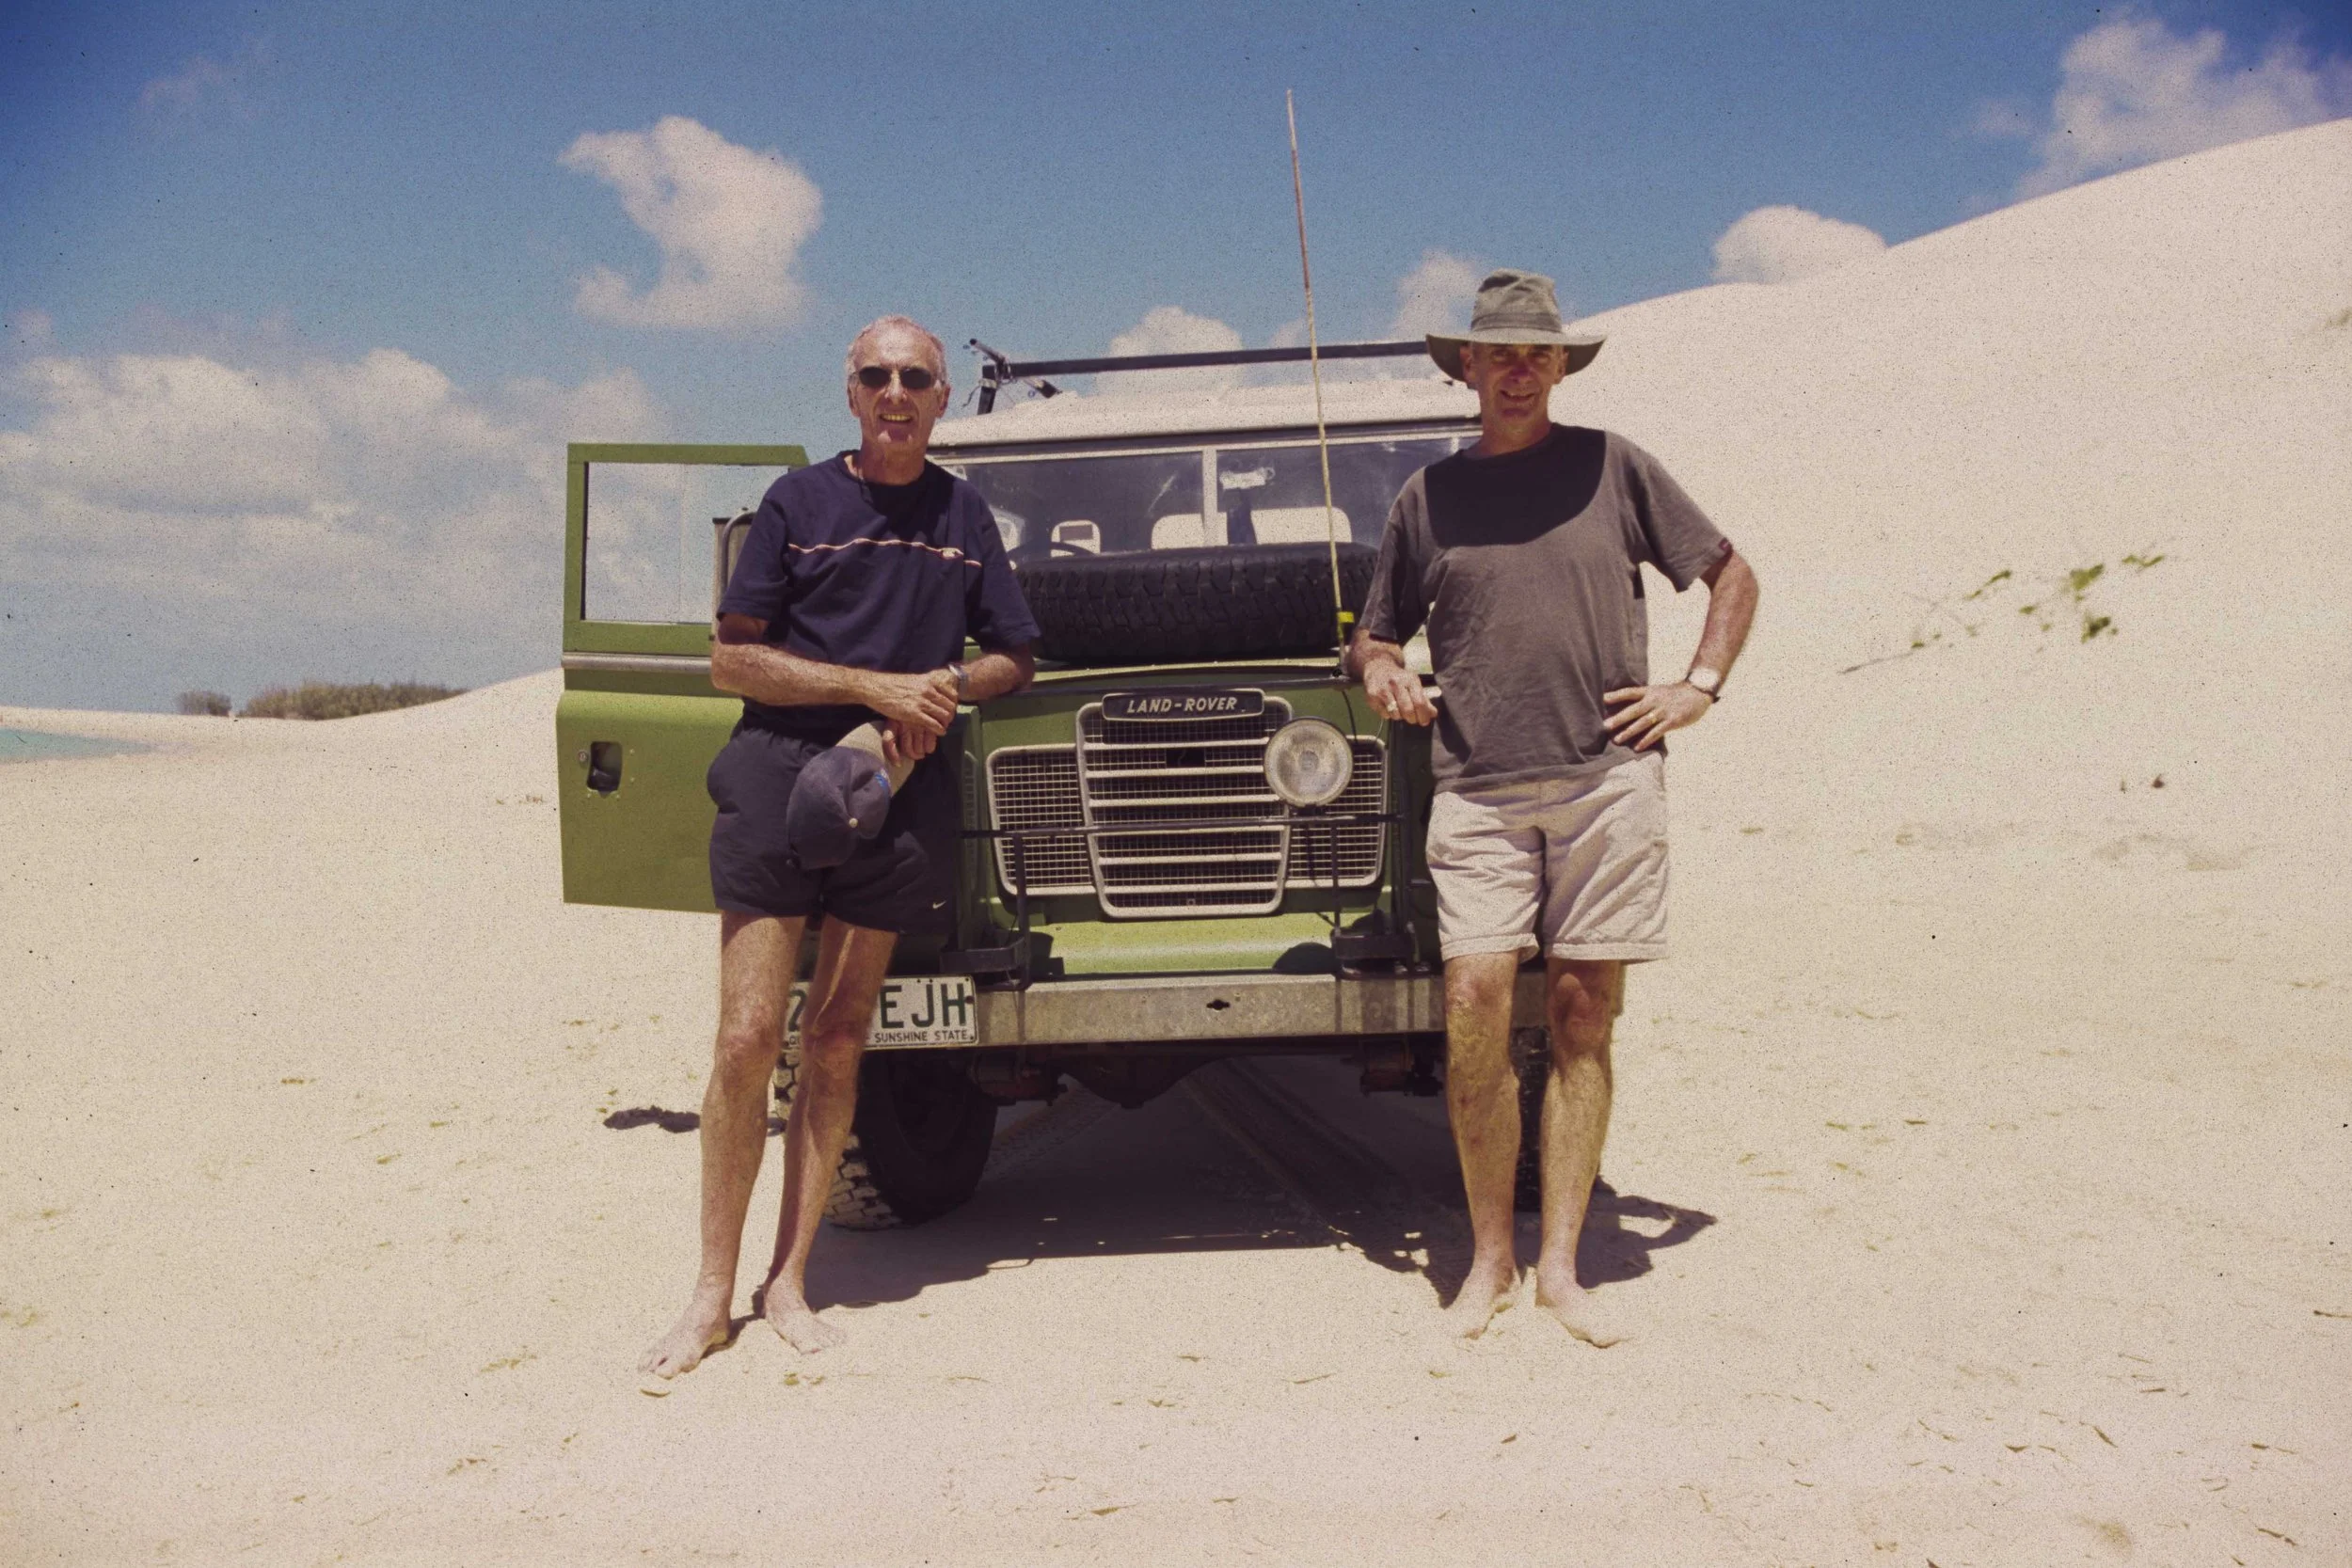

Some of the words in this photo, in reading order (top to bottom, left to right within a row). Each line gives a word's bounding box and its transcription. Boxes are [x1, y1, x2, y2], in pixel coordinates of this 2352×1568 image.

[1127, 696, 1237, 714] LAND-ROVER
[880, 983, 965, 1028] EJH
[874, 1032, 929, 1043] SUNSHINE
[934, 1030, 967, 1040] STATE
